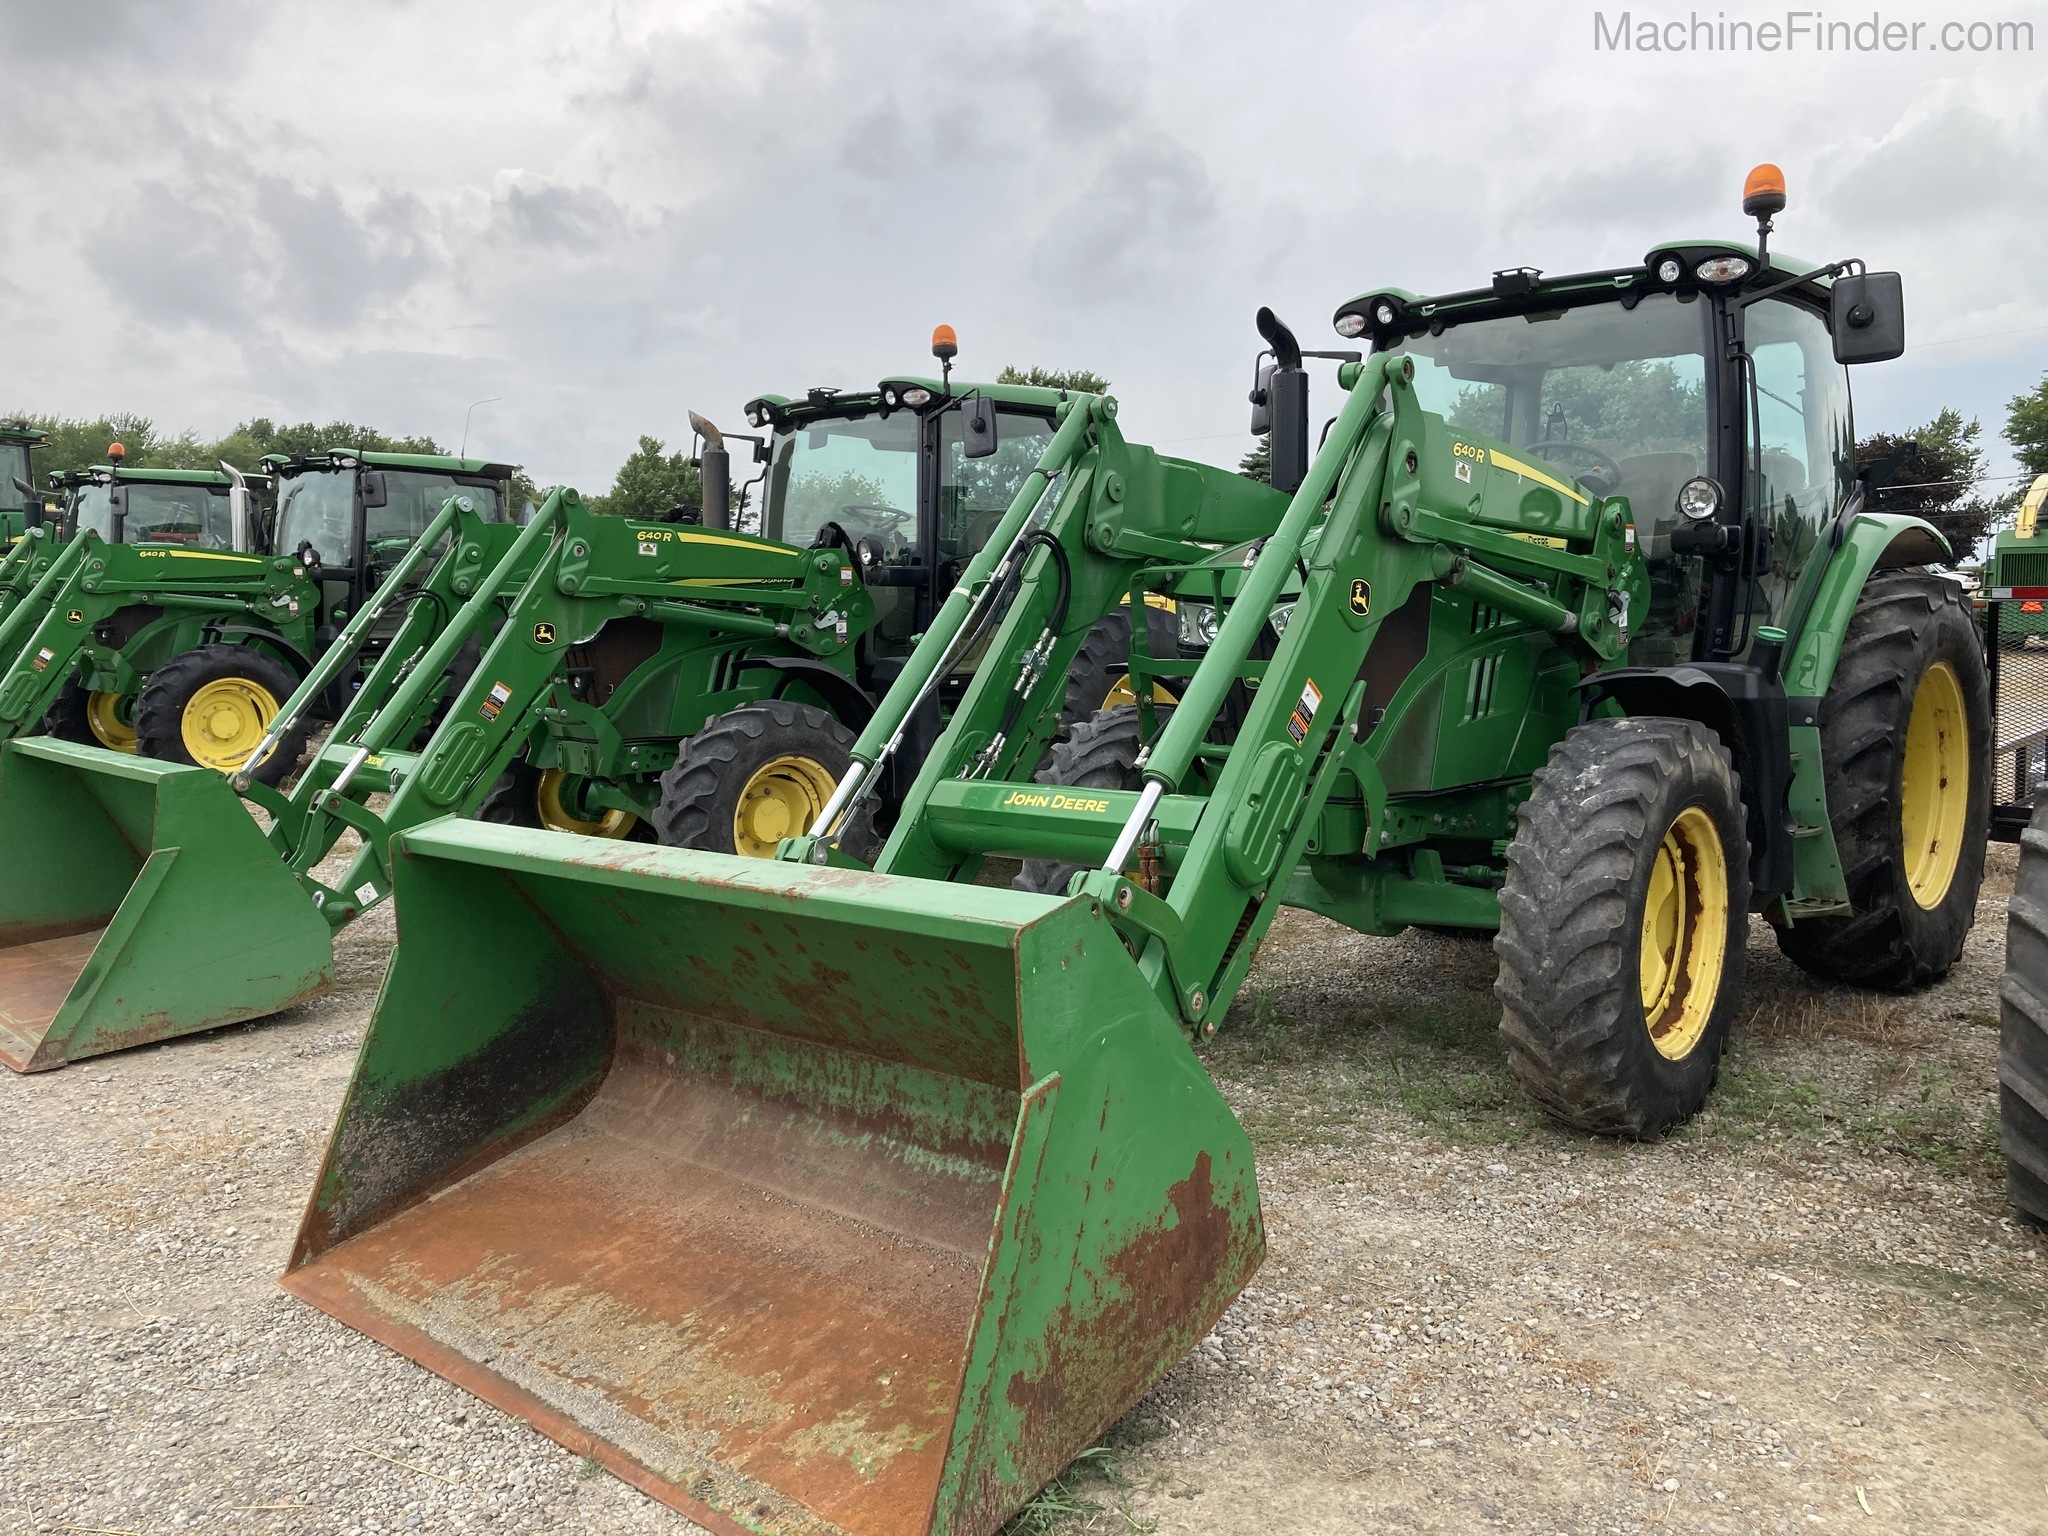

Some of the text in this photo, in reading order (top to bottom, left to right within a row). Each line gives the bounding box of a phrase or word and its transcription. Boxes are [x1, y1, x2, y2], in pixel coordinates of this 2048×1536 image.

[1453, 442, 1485, 464] 640 R
[637, 531, 672, 542] 640 R
[1004, 791, 1109, 812] JOHN DEERE
